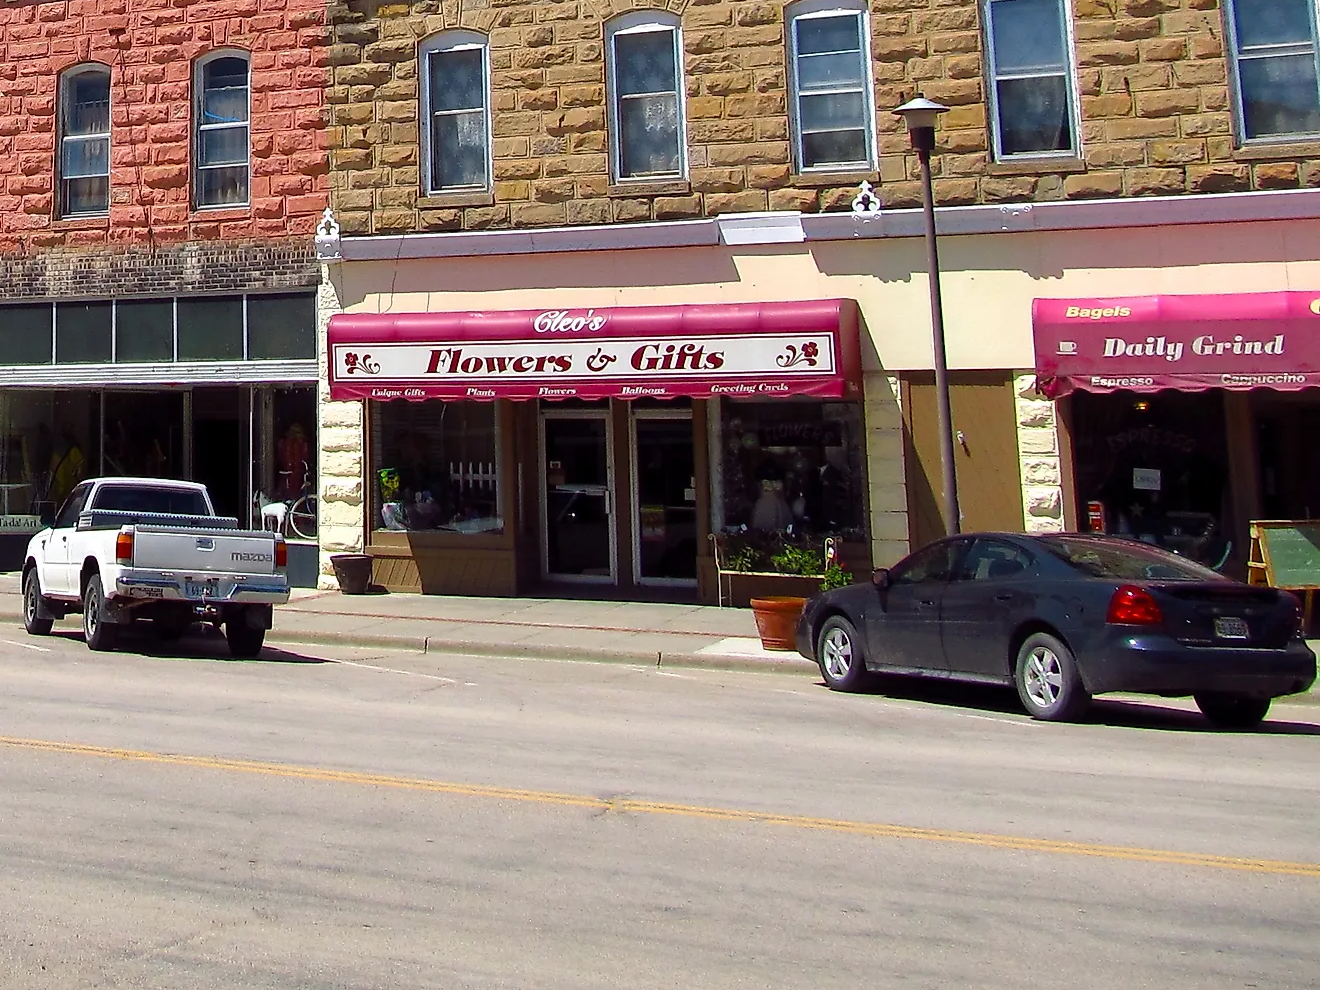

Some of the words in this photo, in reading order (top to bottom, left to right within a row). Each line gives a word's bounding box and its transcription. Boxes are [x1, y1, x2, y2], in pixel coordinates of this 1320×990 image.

[1066, 306, 1131, 319] Bagels
[533, 309, 607, 333] Cleo's
[1102, 336, 1183, 361] Daily
[1192, 334, 1285, 356] Grind
[424, 347, 573, 374] Flowers
[586, 347, 617, 372] &
[630, 343, 724, 371] Gifts
[1090, 376, 1154, 388] Espresso
[1221, 373, 1306, 386] Cappuccino
[371, 388, 402, 397] Unique
[403, 388, 426, 397] Gifts
[466, 387, 496, 396] Plants
[538, 387, 577, 395] Flowers
[621, 386, 665, 394] Balloons
[710, 384, 756, 393] Greeting
[758, 383, 789, 392] Cards
[231, 552, 272, 562] mazda
